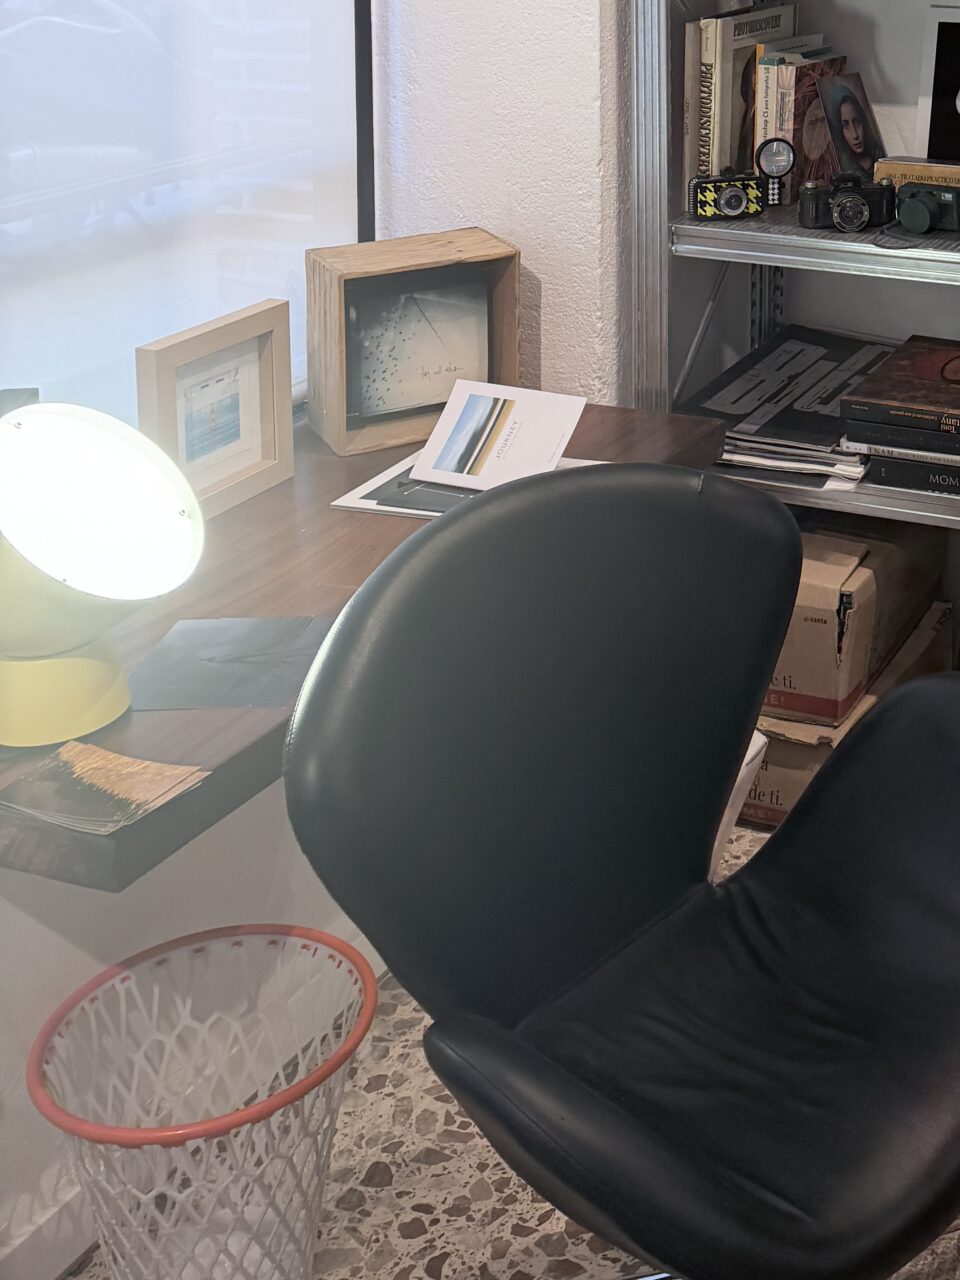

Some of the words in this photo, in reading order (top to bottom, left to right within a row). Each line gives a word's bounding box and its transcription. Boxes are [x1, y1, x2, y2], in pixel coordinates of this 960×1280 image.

[940, 424, 957, 433] Toni
[496, 420, 520, 459] JOURNEY
[749, 785, 765, 802] de
